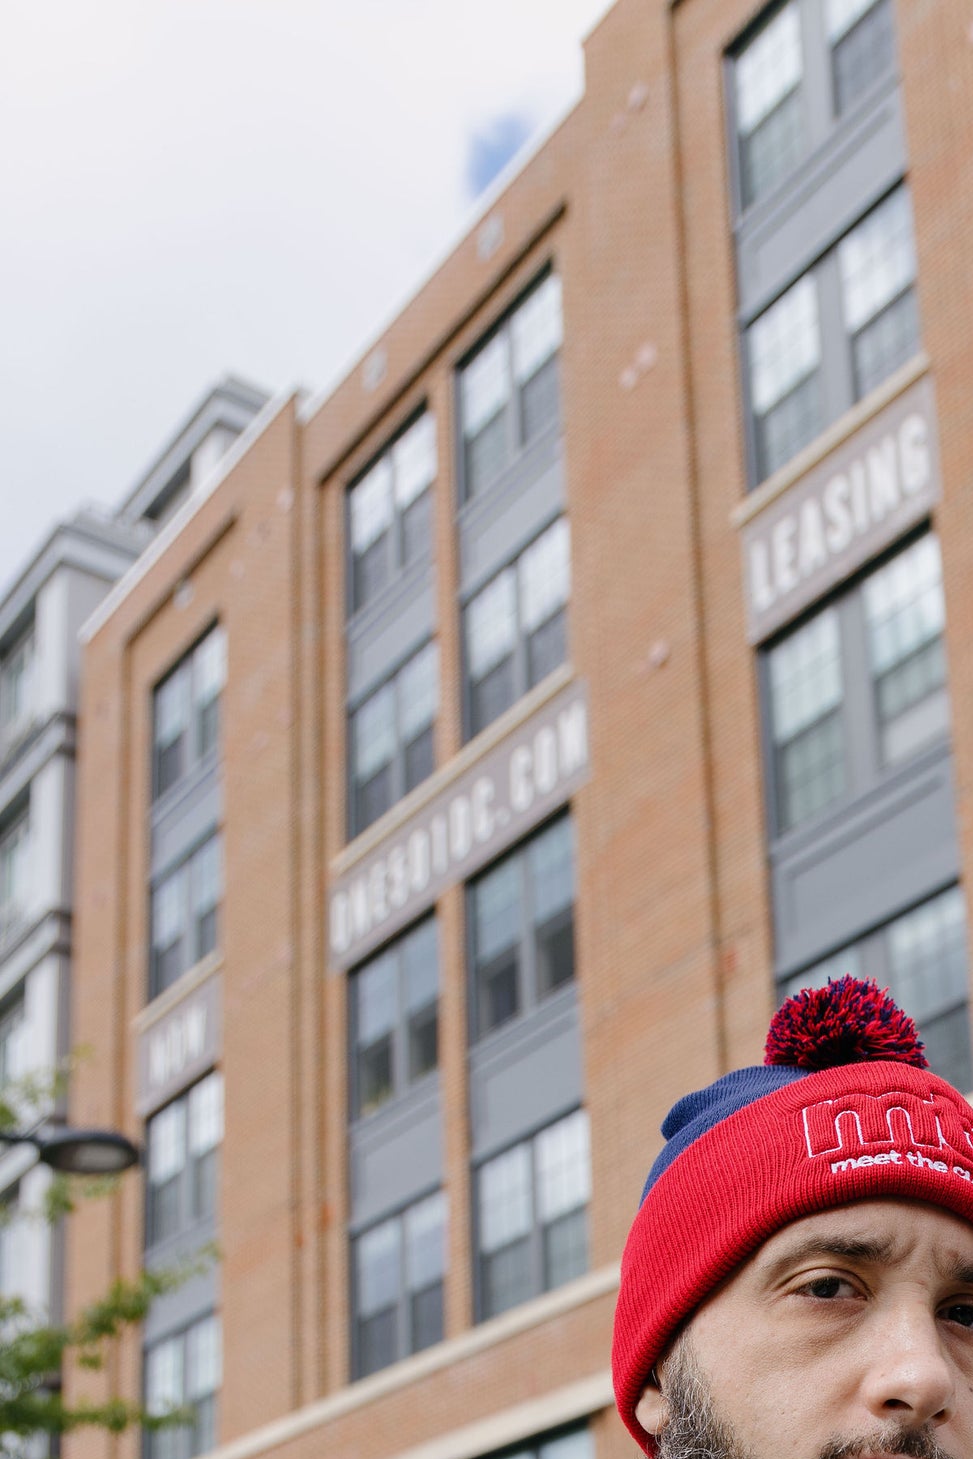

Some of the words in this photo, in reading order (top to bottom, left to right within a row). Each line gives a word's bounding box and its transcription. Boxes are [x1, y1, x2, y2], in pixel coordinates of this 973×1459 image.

[749, 413, 931, 612] LEASING
[830, 1149, 904, 1174] meet
[905, 1150, 949, 1174] the
